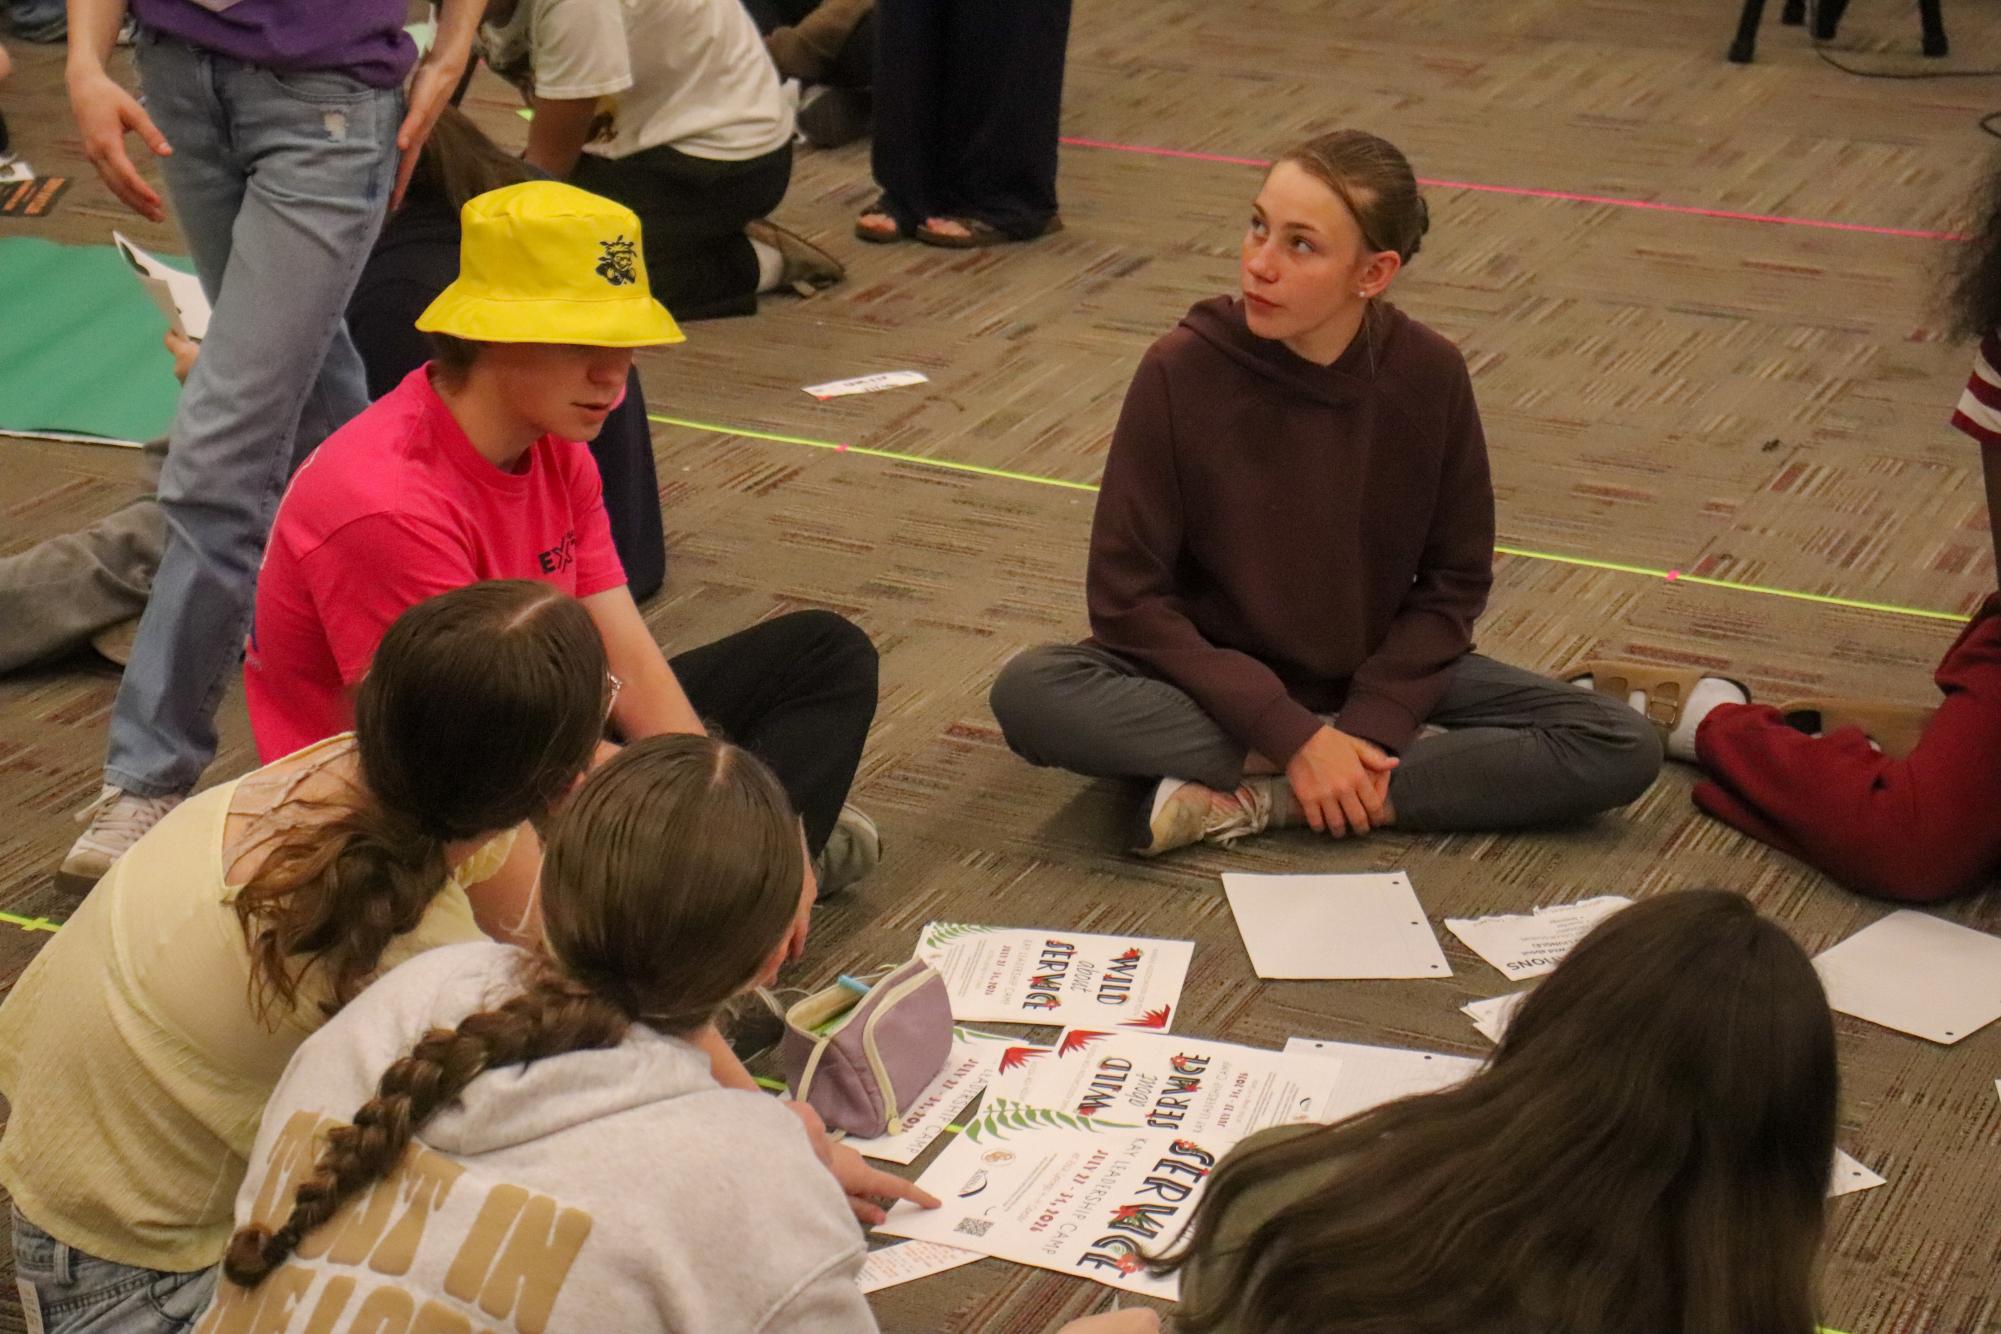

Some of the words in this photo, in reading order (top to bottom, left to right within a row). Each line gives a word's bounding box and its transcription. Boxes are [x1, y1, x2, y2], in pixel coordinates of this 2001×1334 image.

[1022, 939, 1076, 1010] SERVICE
[1070, 960, 1095, 993] about
[1097, 953, 1141, 1005] WILD
[1506, 956, 1564, 971] IONS
[953, 1059, 979, 1077] JULY
[1078, 1057, 1133, 1110] WILD
[1128, 1072, 1159, 1108] about
[1147, 1052, 1211, 1130] SERVICE
[906, 1124, 942, 1153] CAMP
[1123, 1138, 1147, 1157] KAY
[1083, 1149, 1109, 1172] JULY
[1072, 1160, 1131, 1220] LEADERSHIP
[1029, 1209, 1059, 1232] 2026
[1076, 1138, 1216, 1279] SERVICE
[1042, 1222, 1078, 1255] CAMP
[443, 1184, 593, 1334] IN
